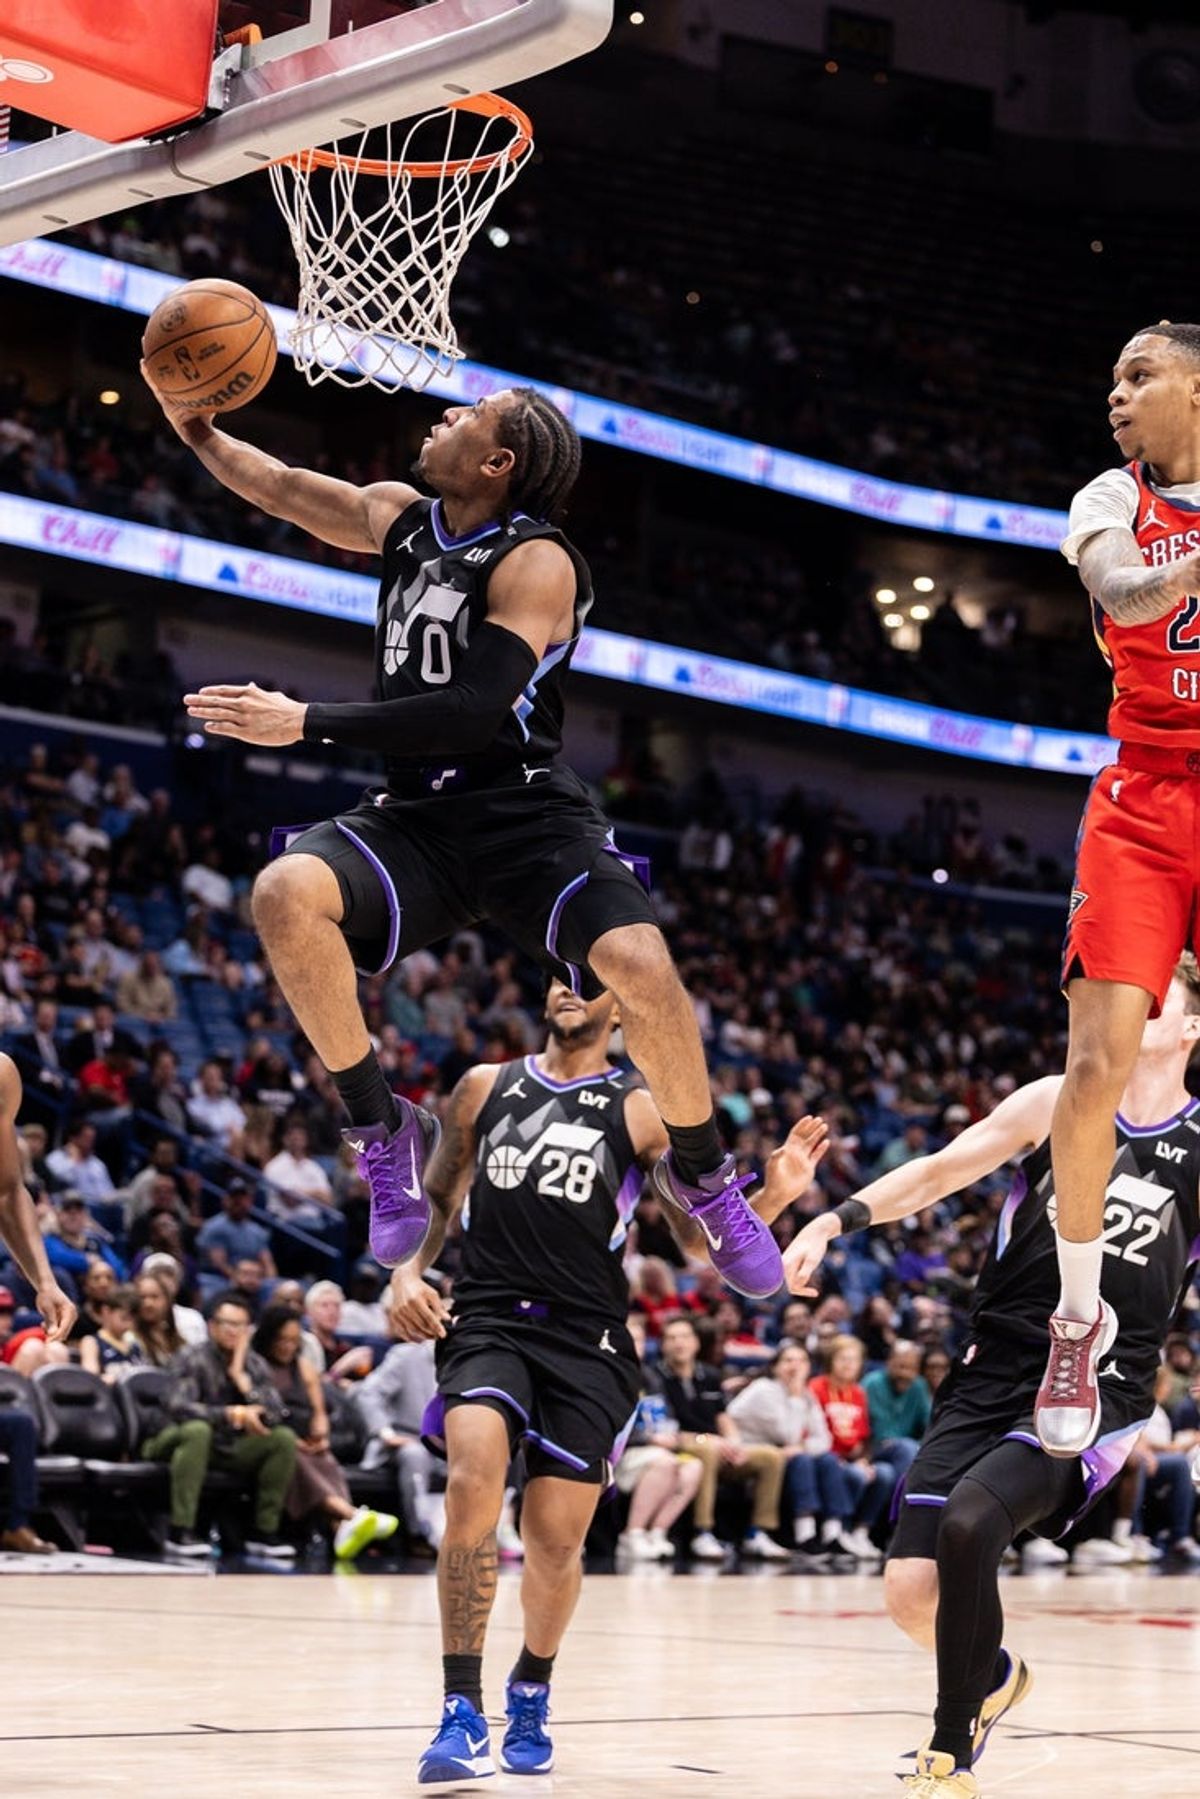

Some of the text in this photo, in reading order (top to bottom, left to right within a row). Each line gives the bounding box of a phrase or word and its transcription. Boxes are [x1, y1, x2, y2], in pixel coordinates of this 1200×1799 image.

[421, 623, 452, 685] 0
[578, 1090, 610, 1109] LVT
[537, 1150, 597, 1203] 28
[1155, 1141, 1188, 1164] LVT
[1102, 1204, 1160, 1267] 22
